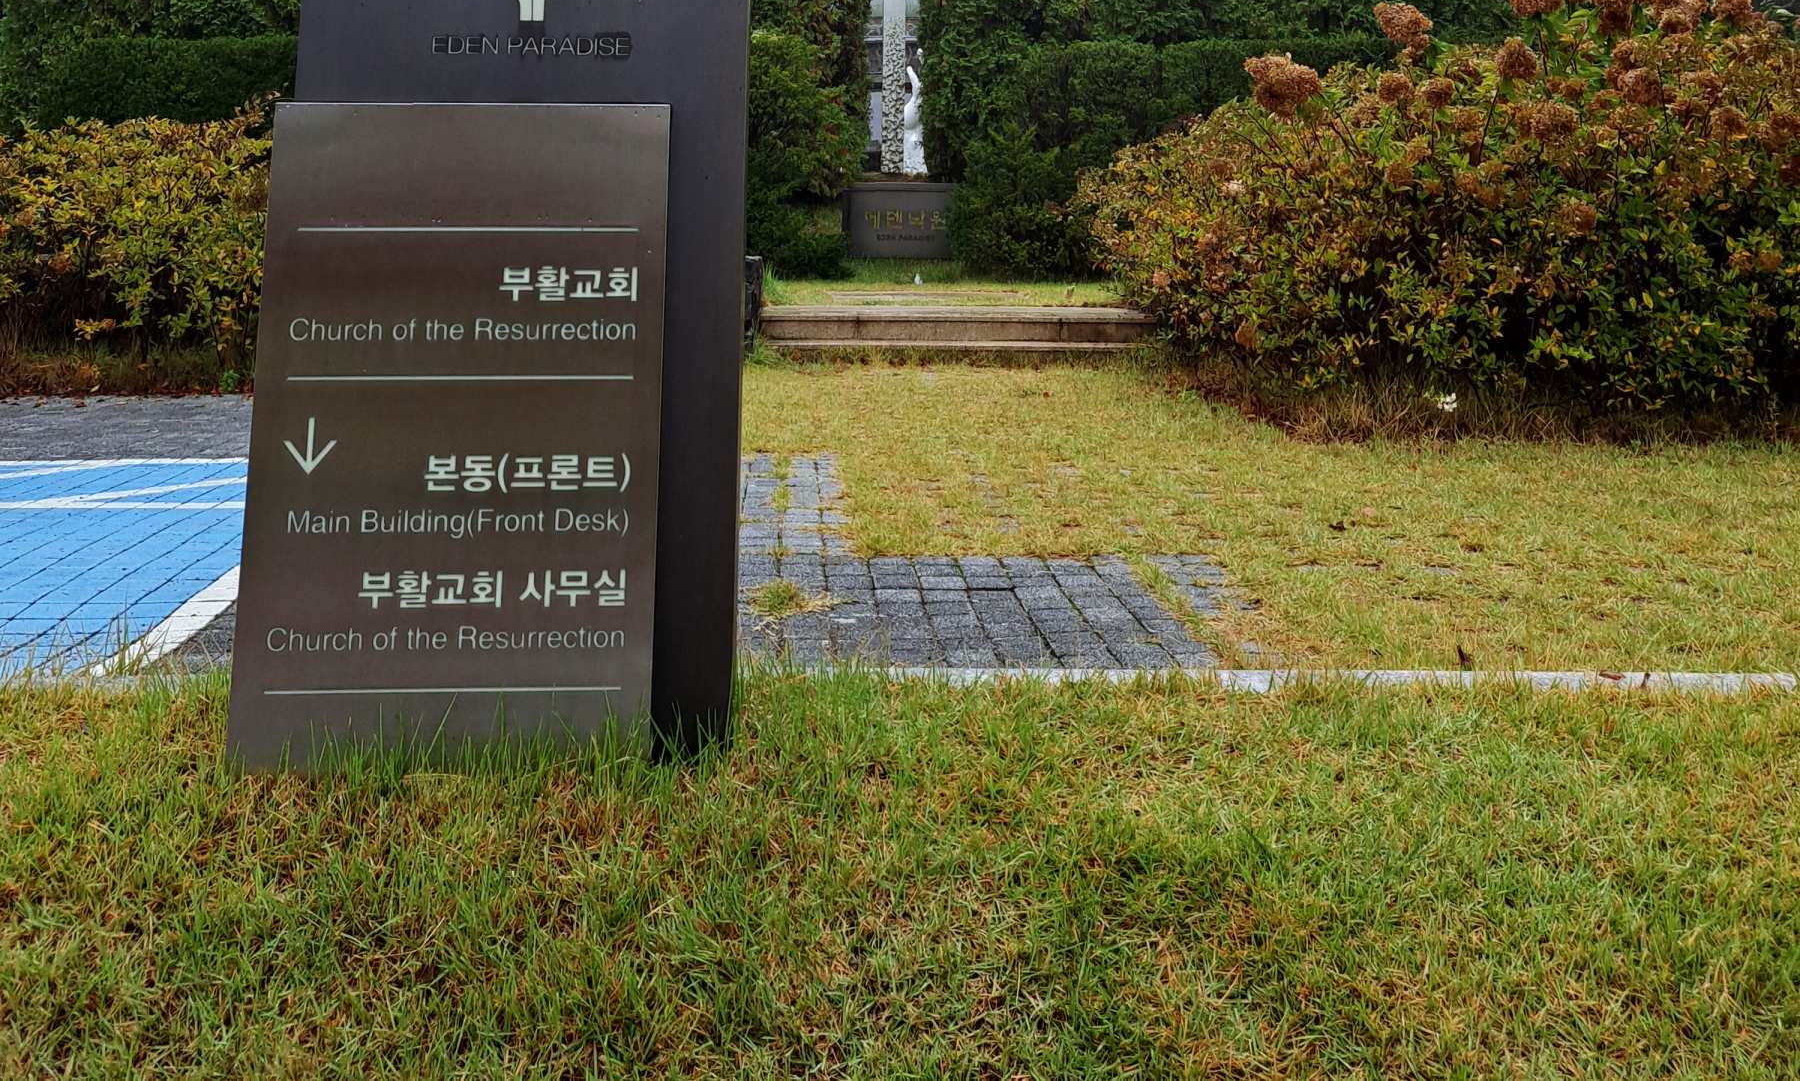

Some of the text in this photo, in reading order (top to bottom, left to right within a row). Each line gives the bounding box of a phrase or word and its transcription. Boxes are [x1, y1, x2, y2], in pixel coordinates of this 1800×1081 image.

[431, 35, 631, 56] EDEN PARADISE
[499, 265, 639, 302] 부활교회
[289, 318, 637, 342] Church of the Resurrection
[424, 452, 631, 494] 본동(프론트)
[287, 508, 629, 540] Main Building(Front Desk)
[357, 569, 627, 609] 부활교회 사무실
[266, 625, 626, 652] Church of the Resurrection
